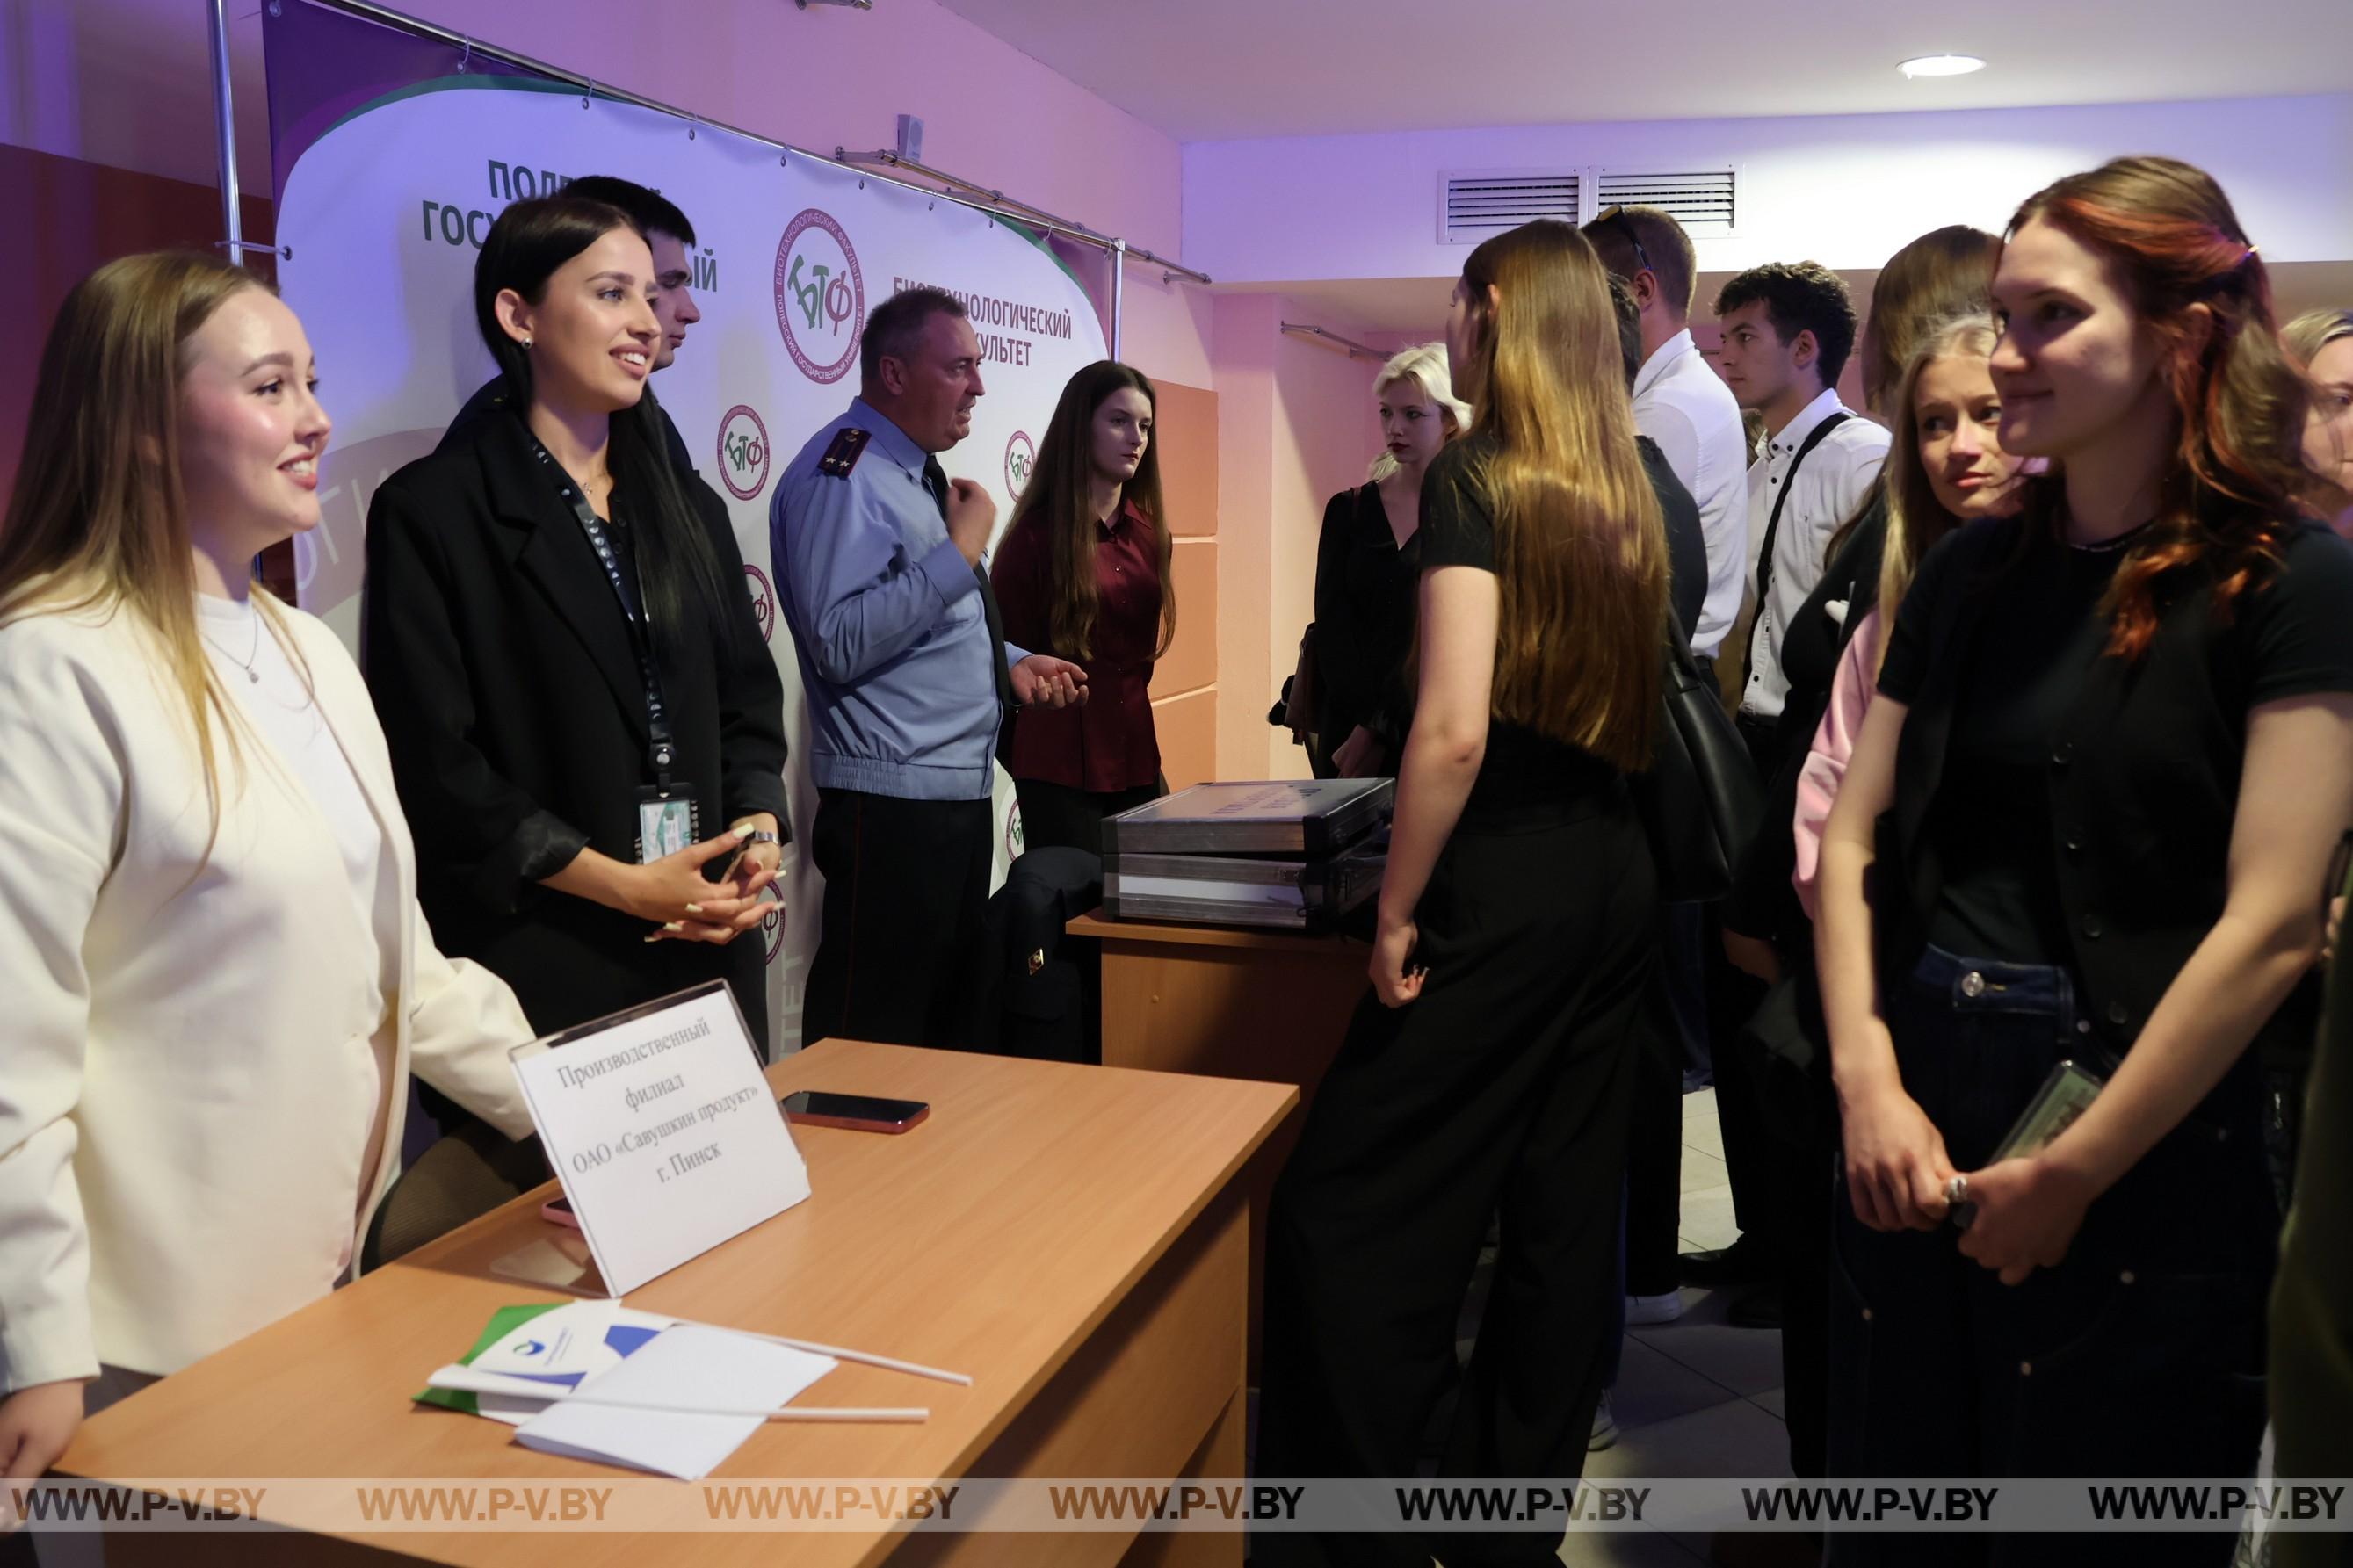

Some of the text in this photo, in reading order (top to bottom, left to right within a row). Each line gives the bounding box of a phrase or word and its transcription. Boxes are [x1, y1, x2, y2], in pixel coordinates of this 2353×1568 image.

[976, 332, 1032, 367] УЛЬТЕТ
[556, 1016, 711, 1090] Производственный
[625, 1073, 685, 1113] филиал
[572, 1085, 759, 1174] ОАО «Савушкин продукт»
[656, 1141, 722, 1184] г. Пинск
